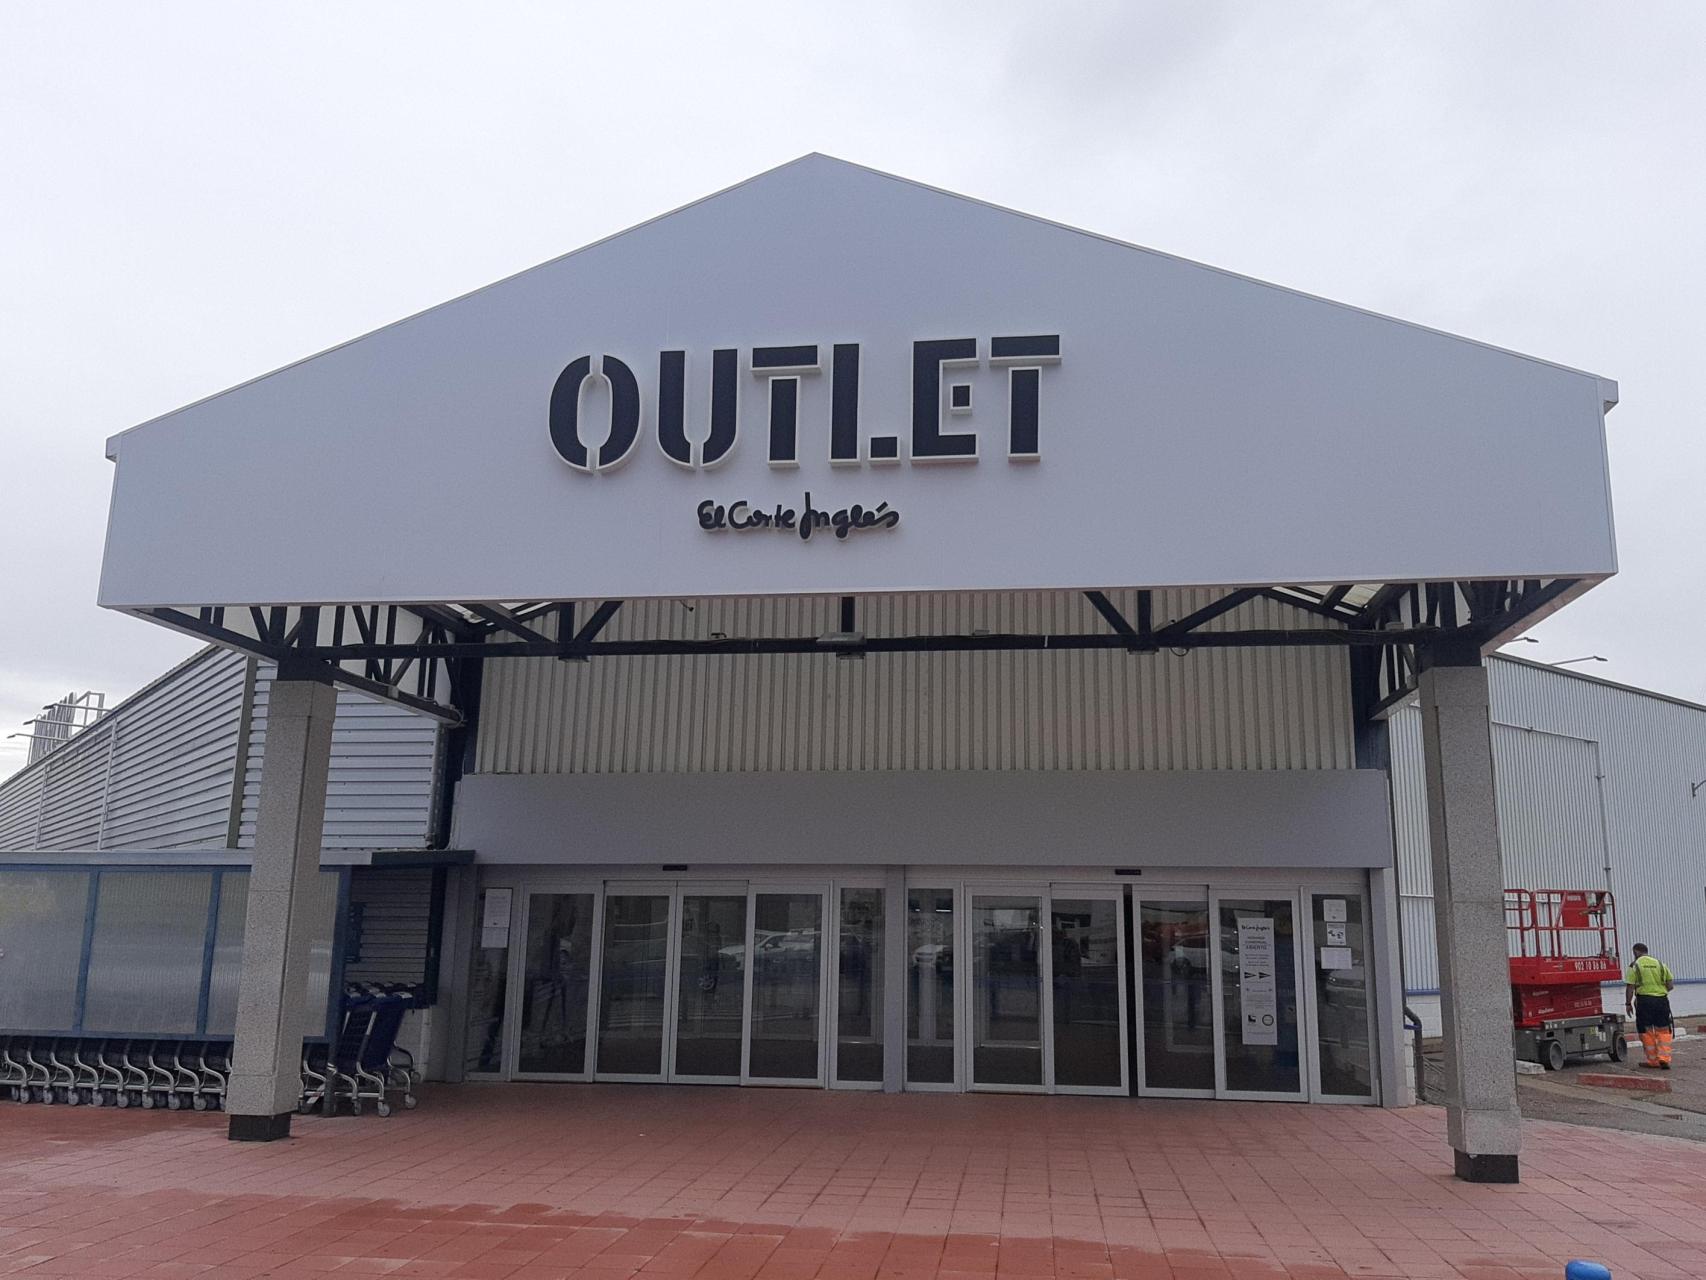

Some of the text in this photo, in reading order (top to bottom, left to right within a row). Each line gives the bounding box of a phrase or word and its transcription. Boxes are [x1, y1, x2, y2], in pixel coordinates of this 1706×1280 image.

[548, 334, 1061, 470] OUTLET
[697, 492, 900, 541] El Corte Inglés
